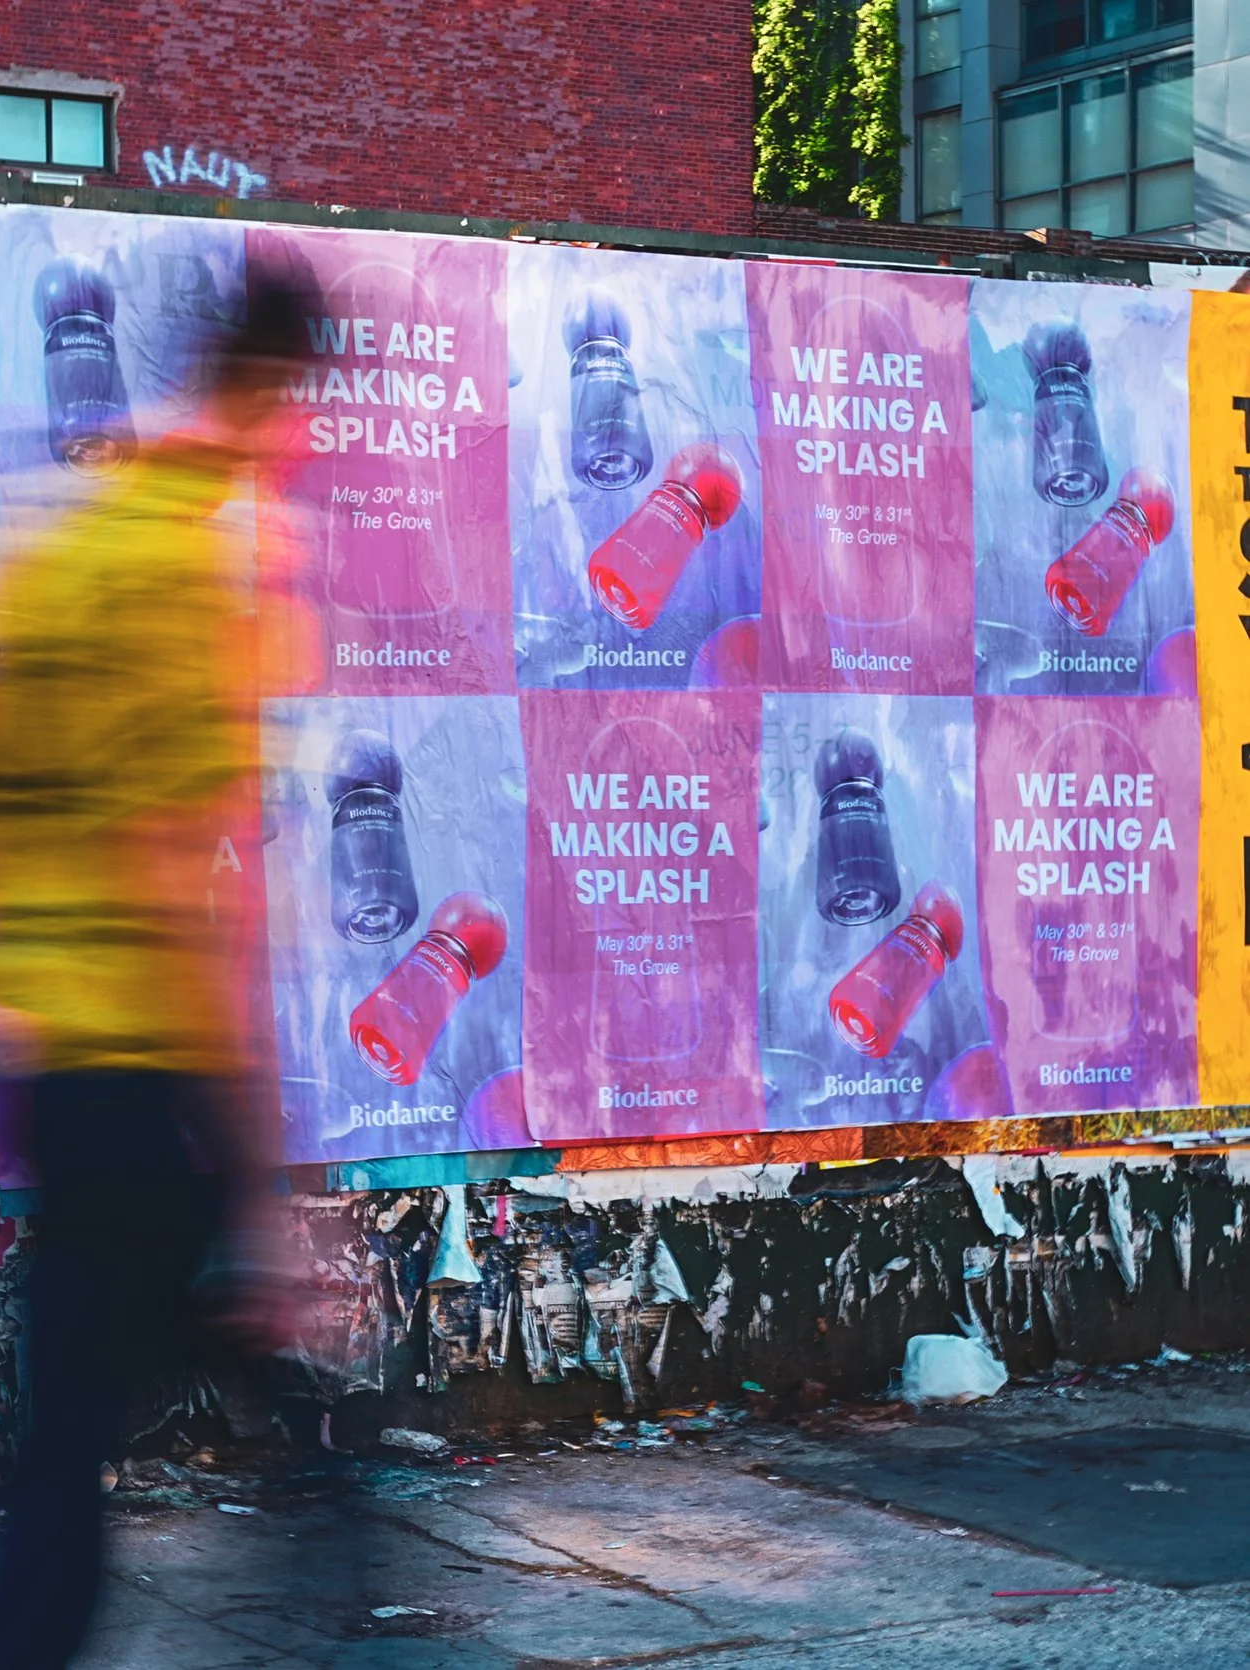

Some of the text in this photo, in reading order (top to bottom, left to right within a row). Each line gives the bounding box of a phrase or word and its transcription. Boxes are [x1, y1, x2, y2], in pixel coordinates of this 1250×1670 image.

[306, 317, 455, 363] WE ARE
[790, 346, 923, 388] WE ARE
[280, 368, 483, 413] MAKING A
[772, 393, 948, 434] MAKING A
[309, 416, 457, 460] SPLASH
[795, 439, 925, 479] SPLASH
[331, 486, 367, 507] May
[407, 489, 418, 504] &
[352, 511, 432, 531] The Grove
[815, 504, 842, 523] May
[874, 506, 884, 521] &
[828, 528, 898, 545] The Grove
[335, 642, 450, 668] Biodance
[583, 644, 686, 668] Biodance
[830, 646, 912, 672] Biodance
[1038, 650, 1137, 674] Biodance
[567, 773, 710, 810] WE ARE
[1016, 773, 1154, 807] WE ARE
[349, 806, 393, 819] Biodance
[550, 822, 734, 857] MAKING A
[993, 818, 1176, 852] MAKING A
[211, 836, 242, 874] A
[575, 869, 710, 905] SPLASH
[1016, 861, 1151, 897] SPLASH
[596, 936, 625, 953] May
[655, 935, 664, 950] &
[1035, 923, 1064, 942] May
[1096, 923, 1106, 939] &
[612, 959, 679, 975] The Grove
[1050, 946, 1119, 963] The Grove
[824, 1073, 923, 1098] Biodance
[1039, 1064, 1132, 1086] Biodance
[598, 1086, 698, 1109] Biodance
[350, 1102, 456, 1130] Biodance
